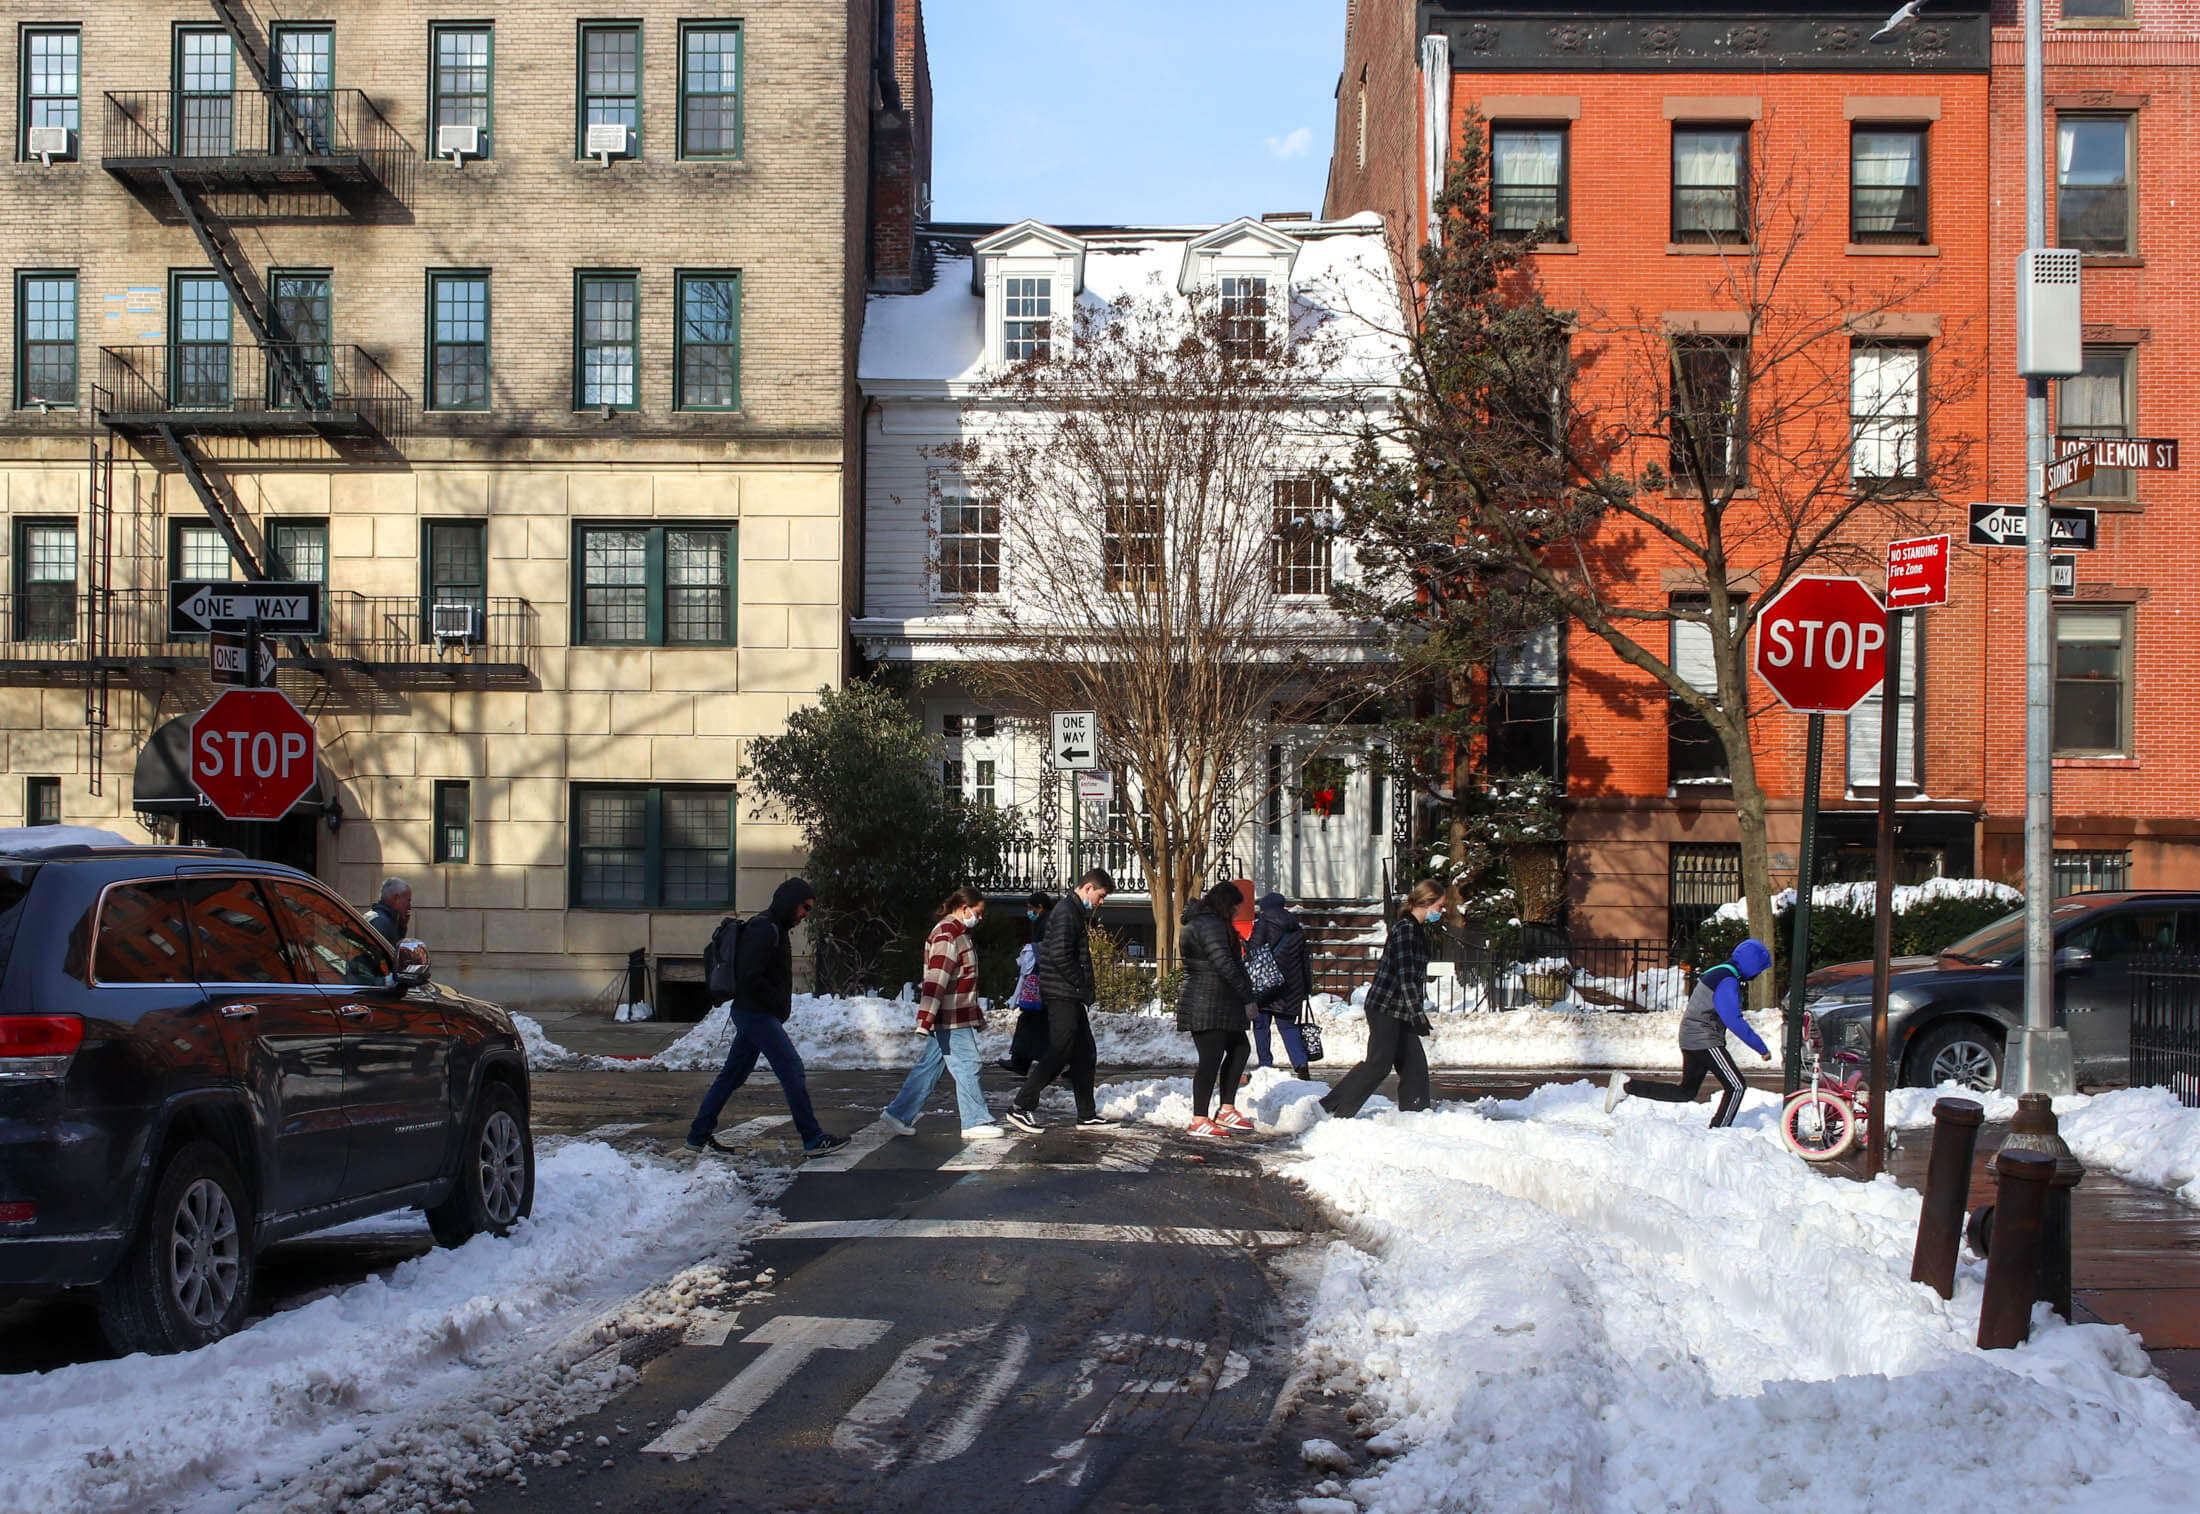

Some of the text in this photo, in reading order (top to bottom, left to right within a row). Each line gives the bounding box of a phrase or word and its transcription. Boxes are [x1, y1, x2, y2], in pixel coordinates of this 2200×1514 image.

[2156, 444, 2174, 468] ST
[2048, 450, 2091, 492] SIDNEY PL
[1988, 517, 2079, 536] ONE AY
[1890, 543, 1939, 562] NO STANDING
[1890, 562, 1923, 578] Fire Zone
[2054, 566, 2069, 584] WAY
[193, 598, 300, 619] ONE WAY
[1767, 617, 1885, 671] STOP
[215, 648, 270, 673] ONE AY
[1062, 717, 1085, 728] ONE
[1062, 732, 1085, 743] WAY
[198, 729, 308, 779] STOP
[600, 1311, 1250, 1488] TOP
